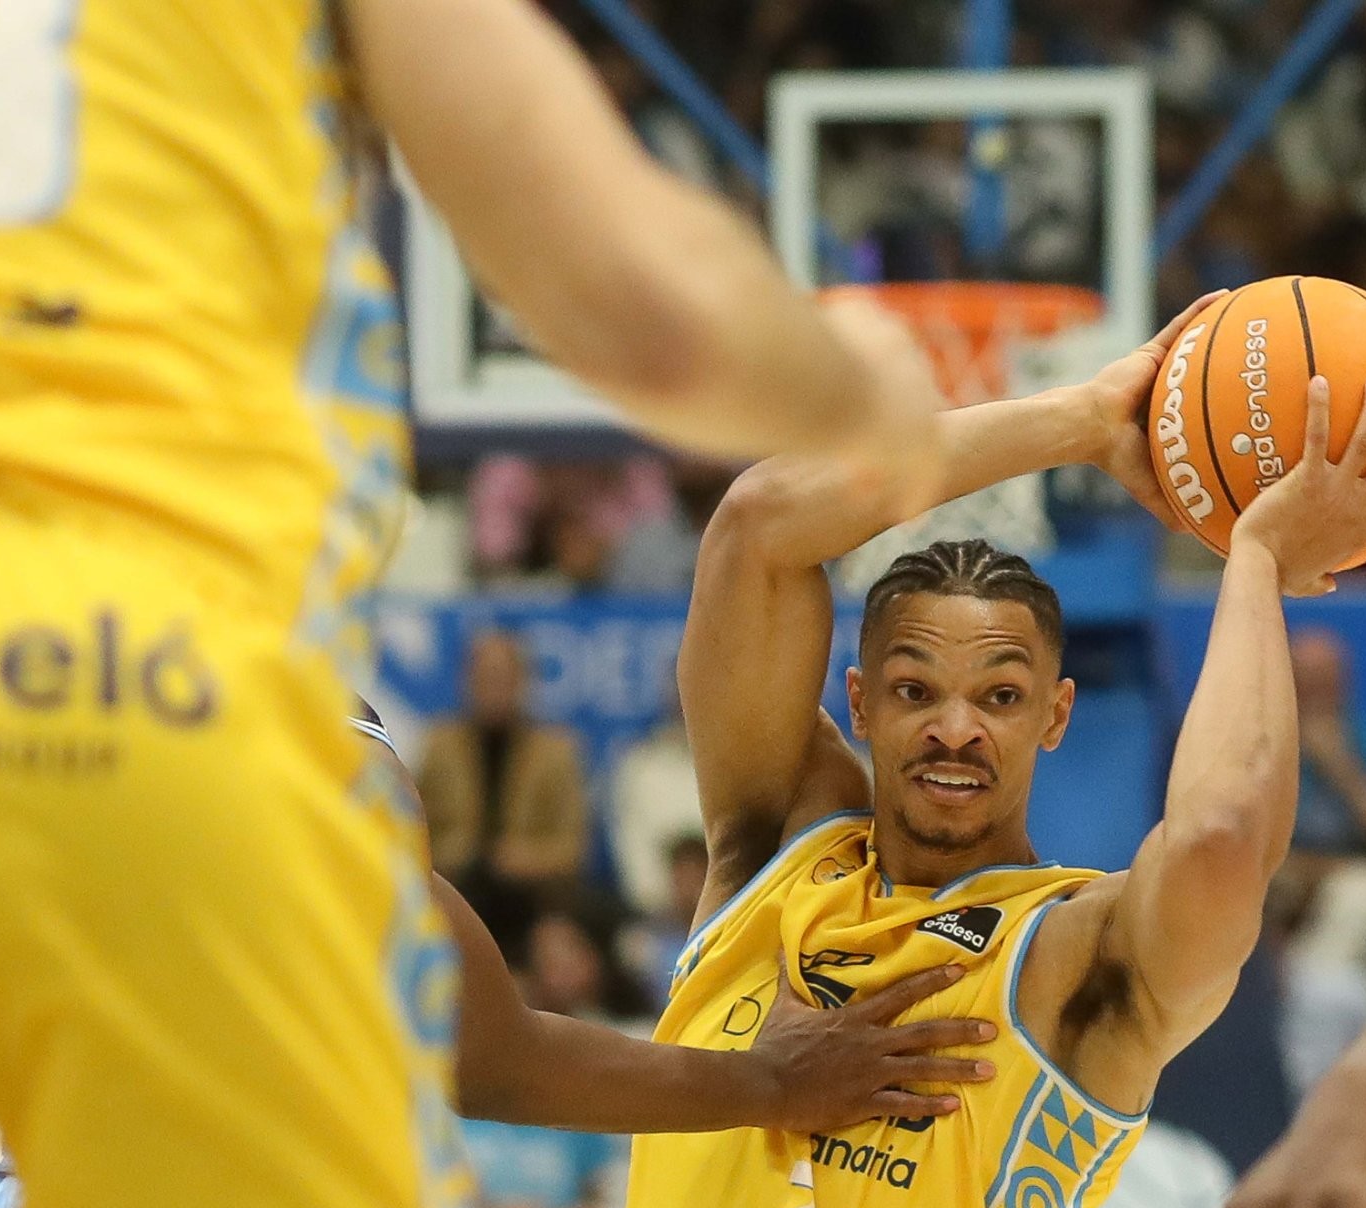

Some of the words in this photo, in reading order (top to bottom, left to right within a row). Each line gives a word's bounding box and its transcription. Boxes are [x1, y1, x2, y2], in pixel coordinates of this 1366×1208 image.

[1156, 321, 1215, 526] Wilson
[923, 919, 985, 948] endesa
[810, 1132, 918, 1190] anaria
